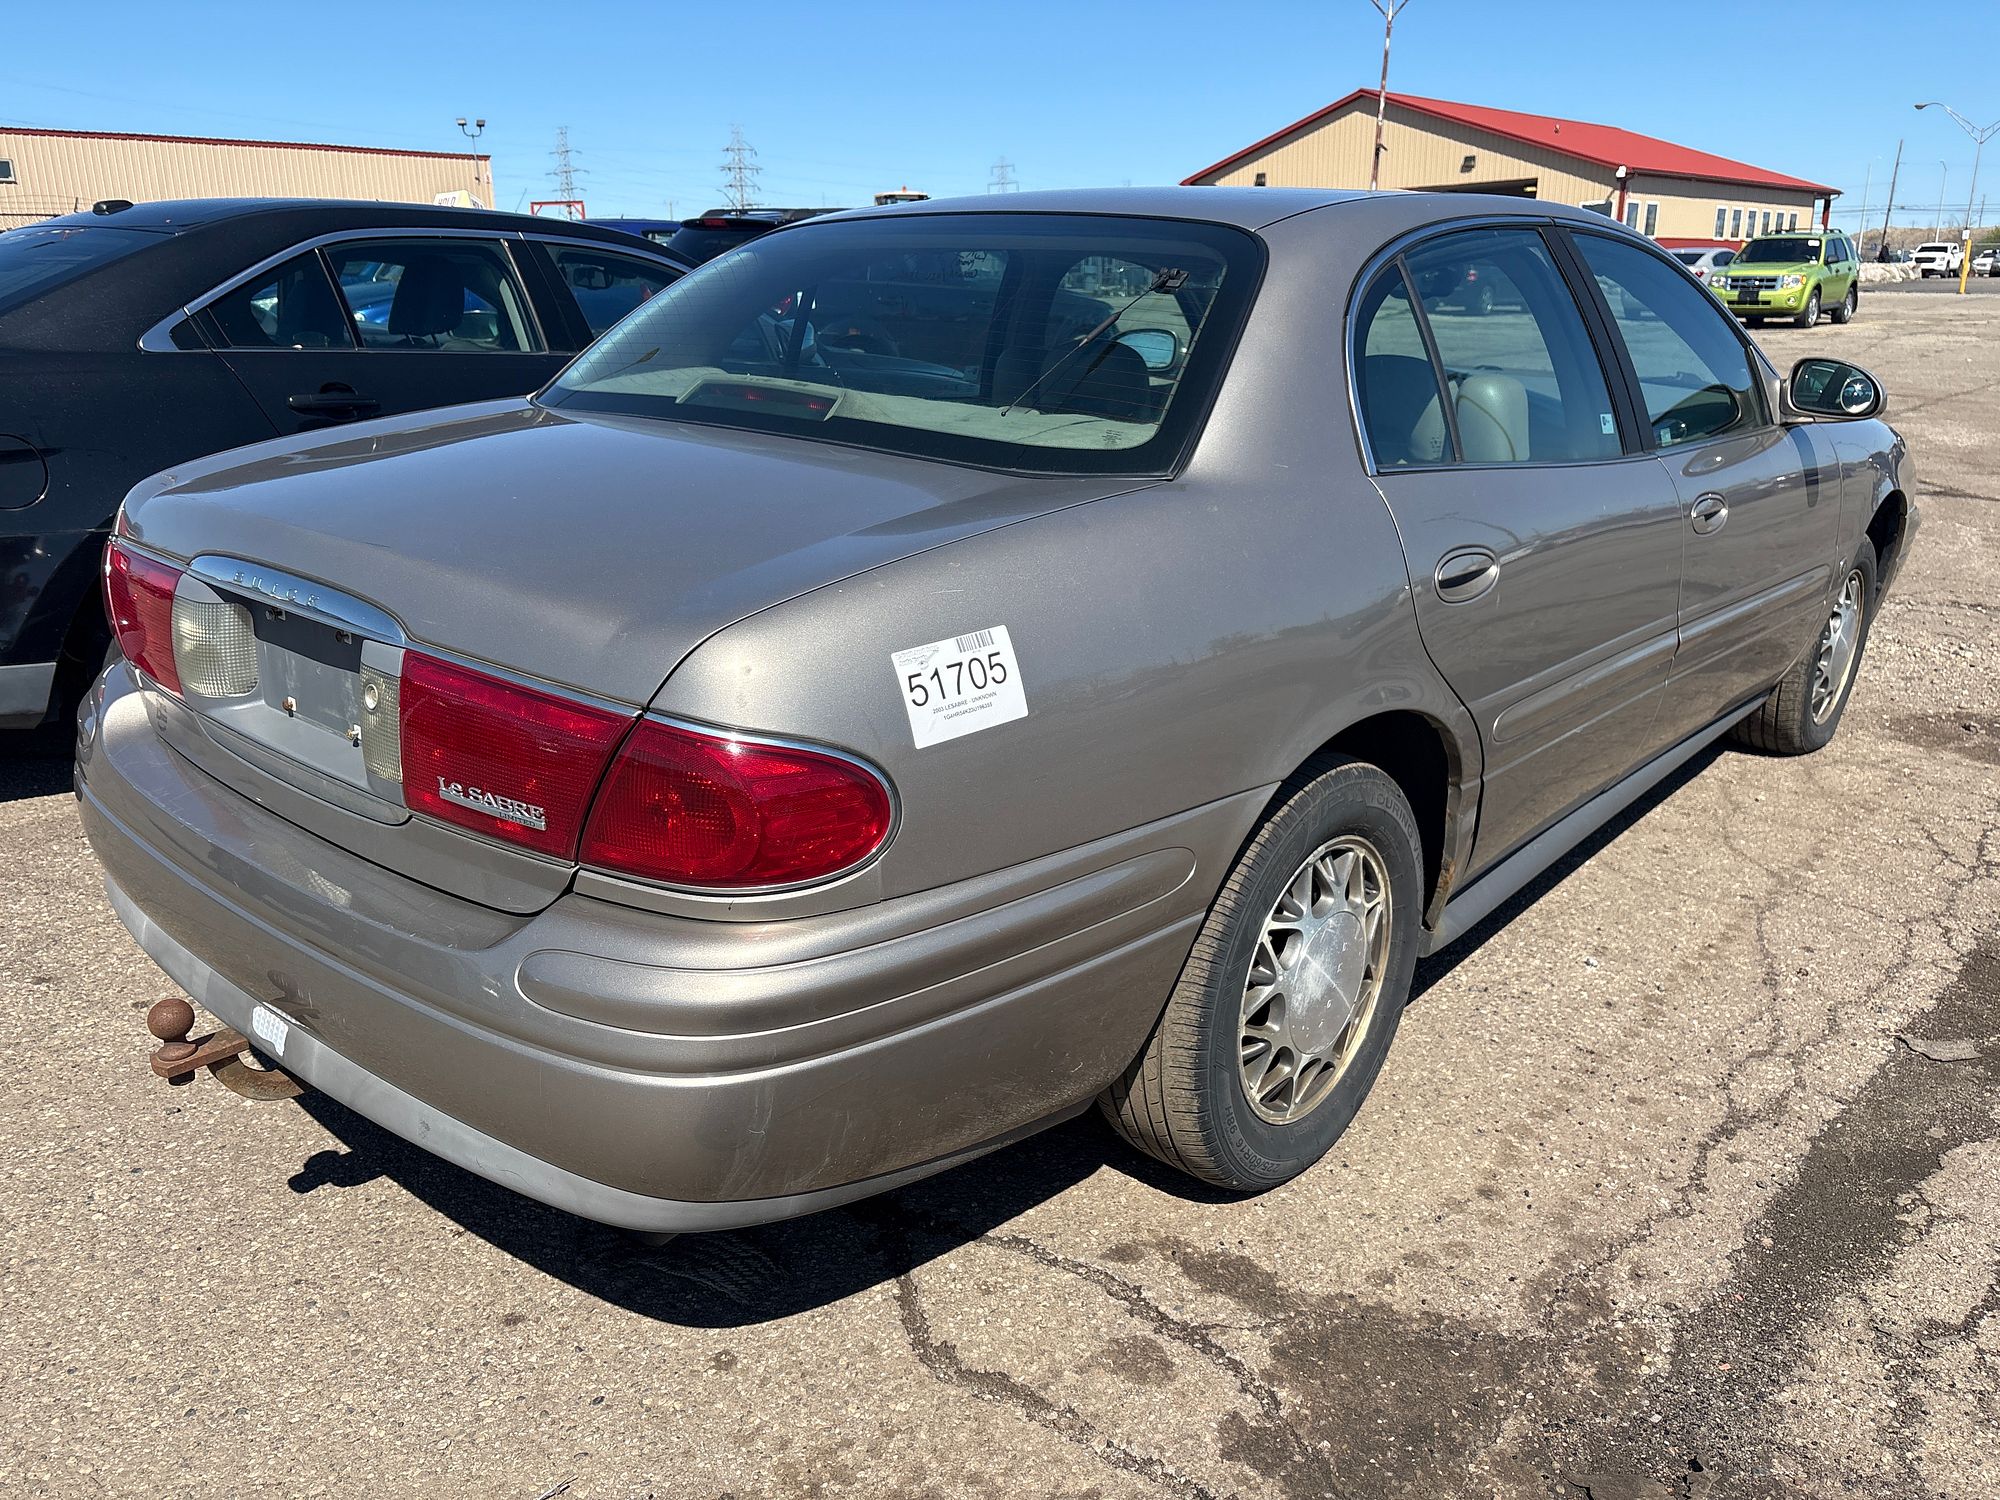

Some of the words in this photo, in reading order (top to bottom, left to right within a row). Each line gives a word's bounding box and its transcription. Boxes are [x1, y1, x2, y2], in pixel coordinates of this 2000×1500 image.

[233, 572, 319, 607] BUICK
[908, 651, 1007, 707] 51705
[944, 699, 968, 711] LESABRE
[971, 691, 997, 703] UNKNOWN
[499, 811, 536, 828] LIMITED
[1224, 1106, 1238, 1134] 98H
[1235, 1138, 1280, 1173] 225/60R16
